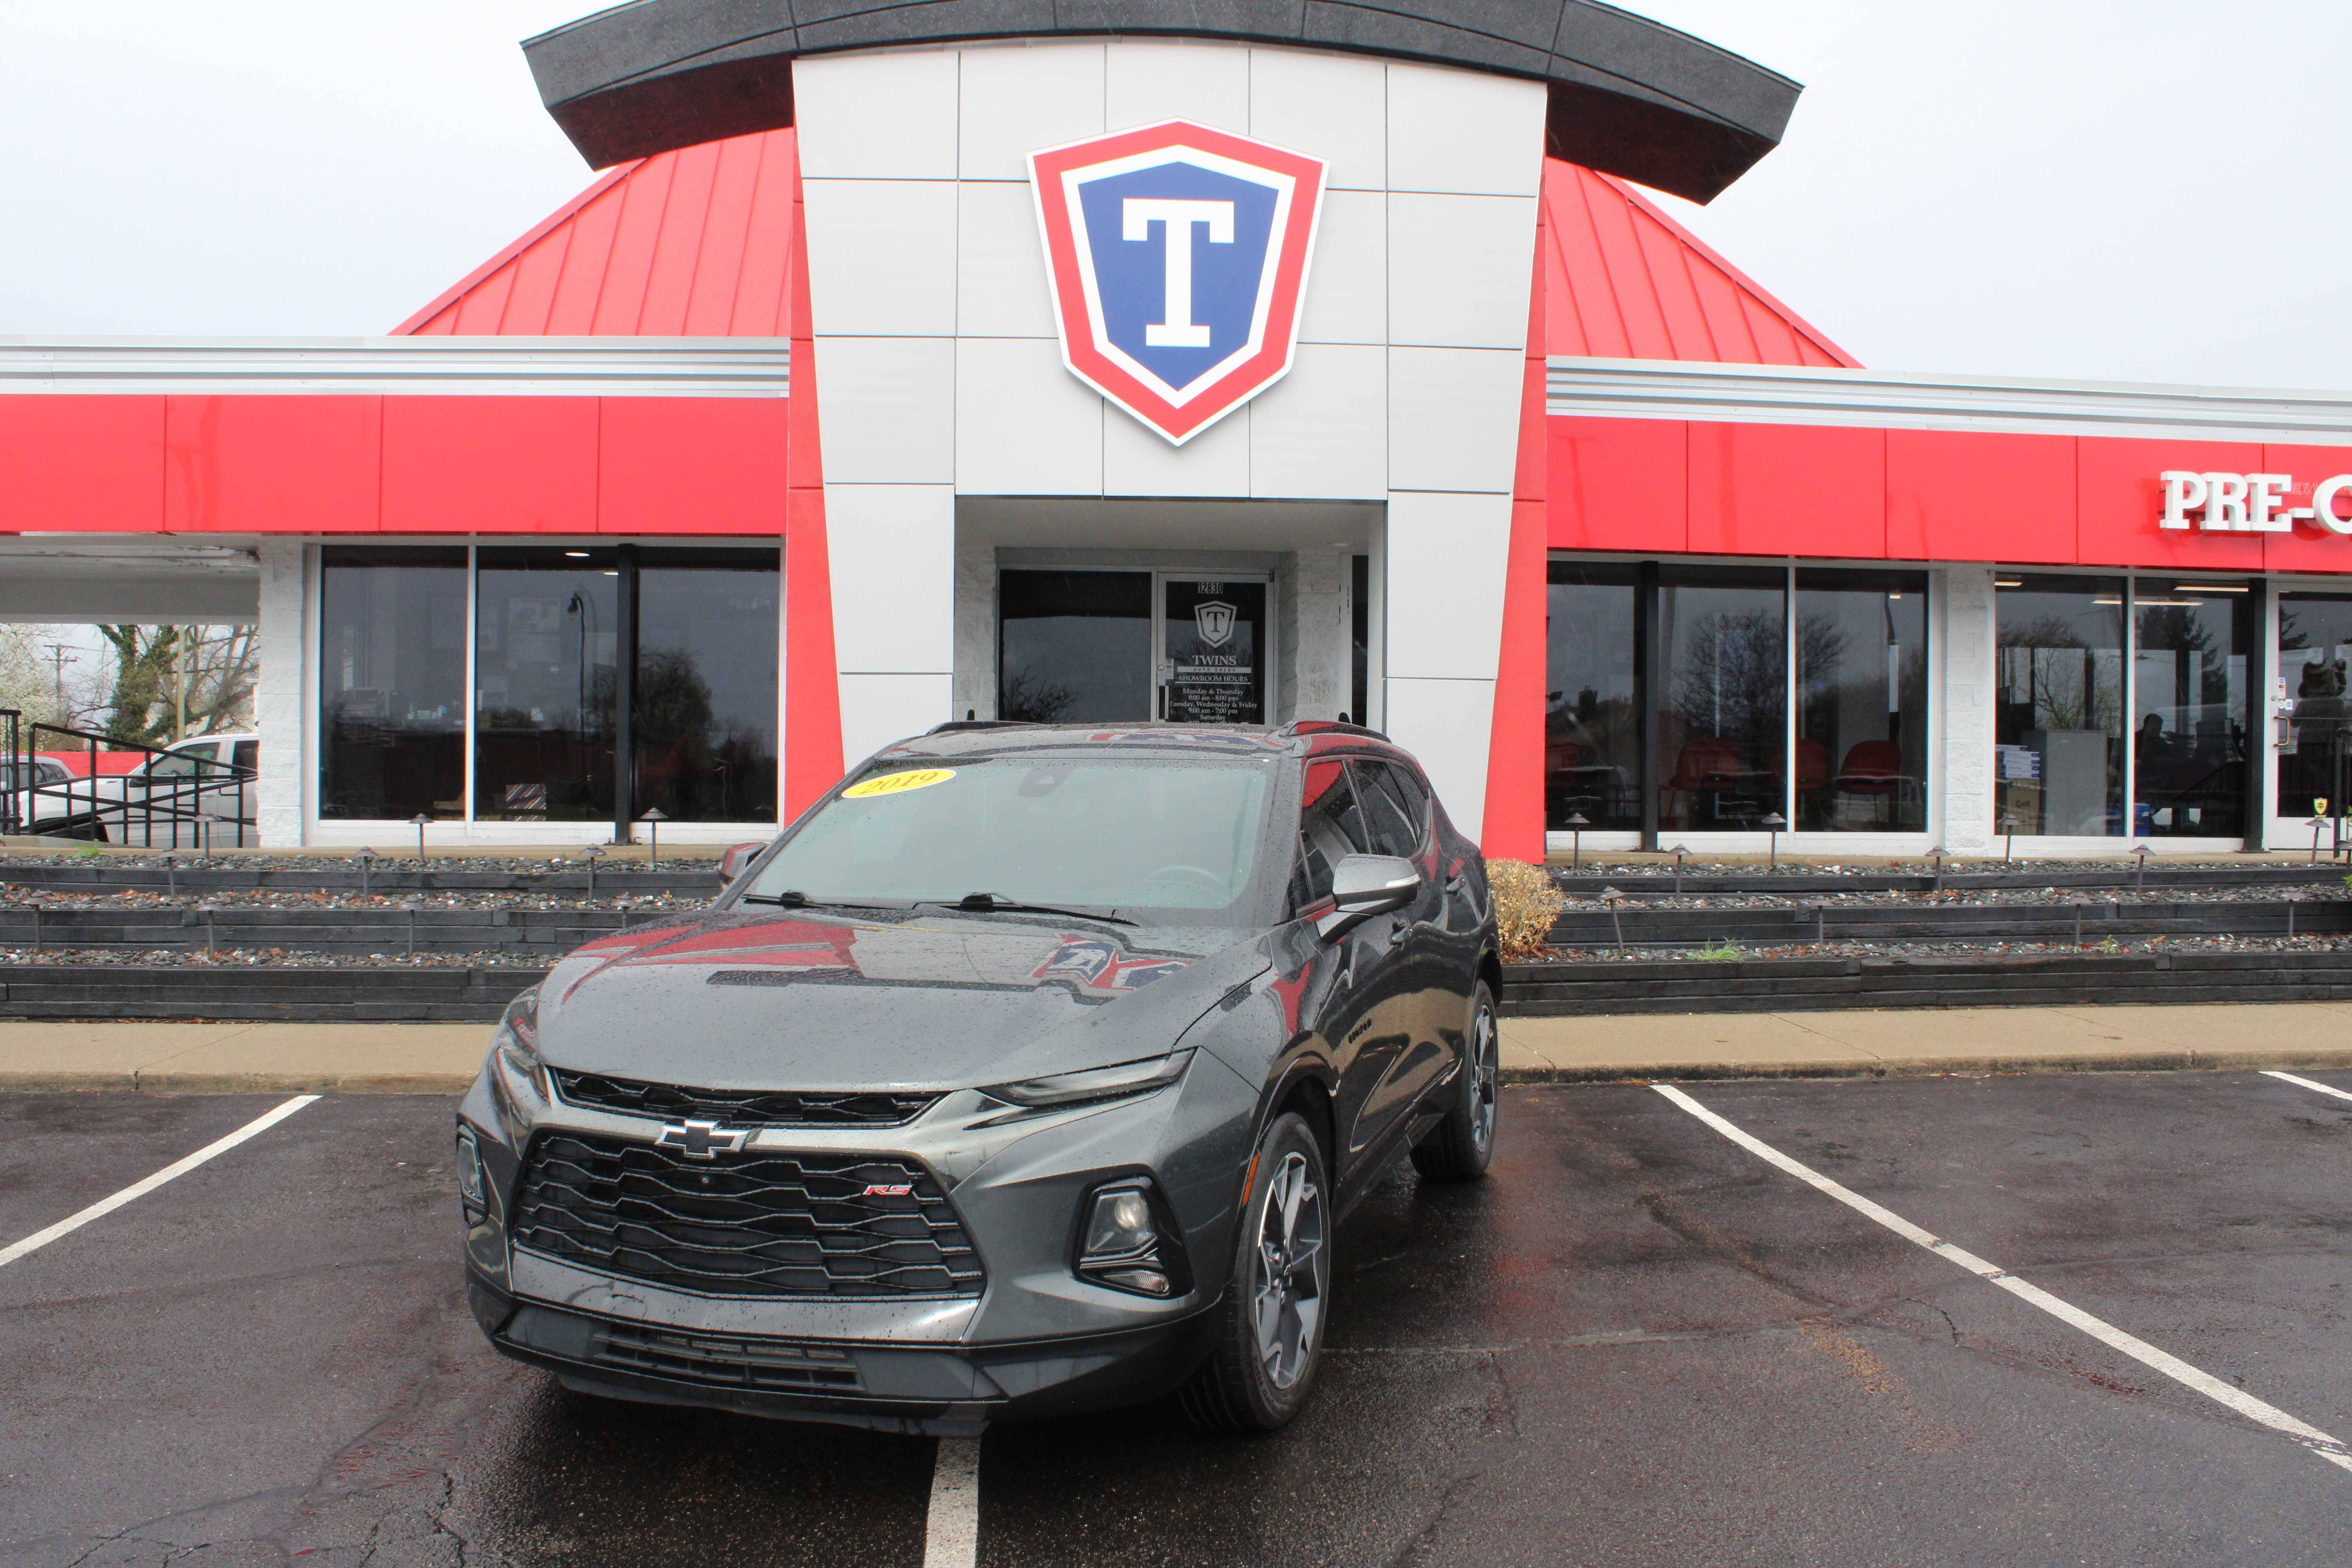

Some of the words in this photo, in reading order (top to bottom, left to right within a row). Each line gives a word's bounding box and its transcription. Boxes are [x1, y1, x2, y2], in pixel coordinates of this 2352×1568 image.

[1123, 198, 1234, 348] T
[1198, 583, 1223, 593] 12830
[1207, 611, 1225, 633] T
[1192, 655, 1237, 666] TWINS
[859, 772, 938, 795] 2019
[862, 1185, 913, 1195] RS
